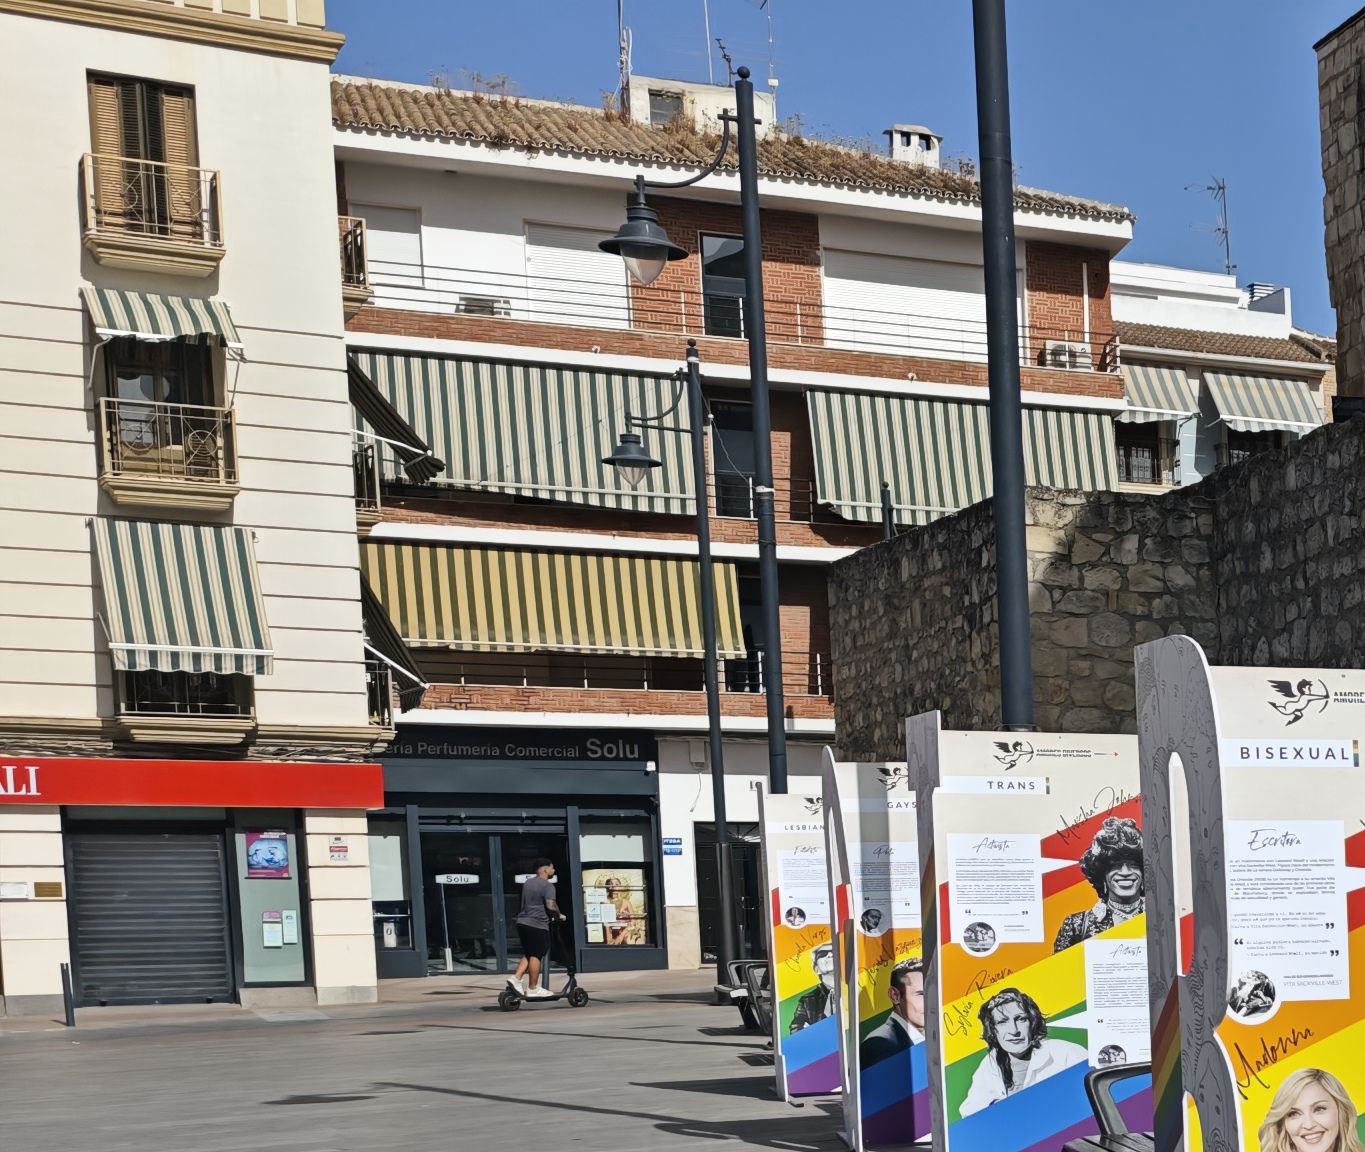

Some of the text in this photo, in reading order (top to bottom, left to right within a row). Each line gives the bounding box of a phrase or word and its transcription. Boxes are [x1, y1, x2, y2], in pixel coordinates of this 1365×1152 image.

[505, 744, 578, 757] Comercial
[586, 739, 639, 758] Solu
[1241, 746, 1349, 760] BISEXUAL
[0, 766, 42, 796] LI
[987, 781, 1035, 790] TRANS
[1248, 829, 1302, 851] Escritora
[1234, 1027, 1315, 1100] Madonna
